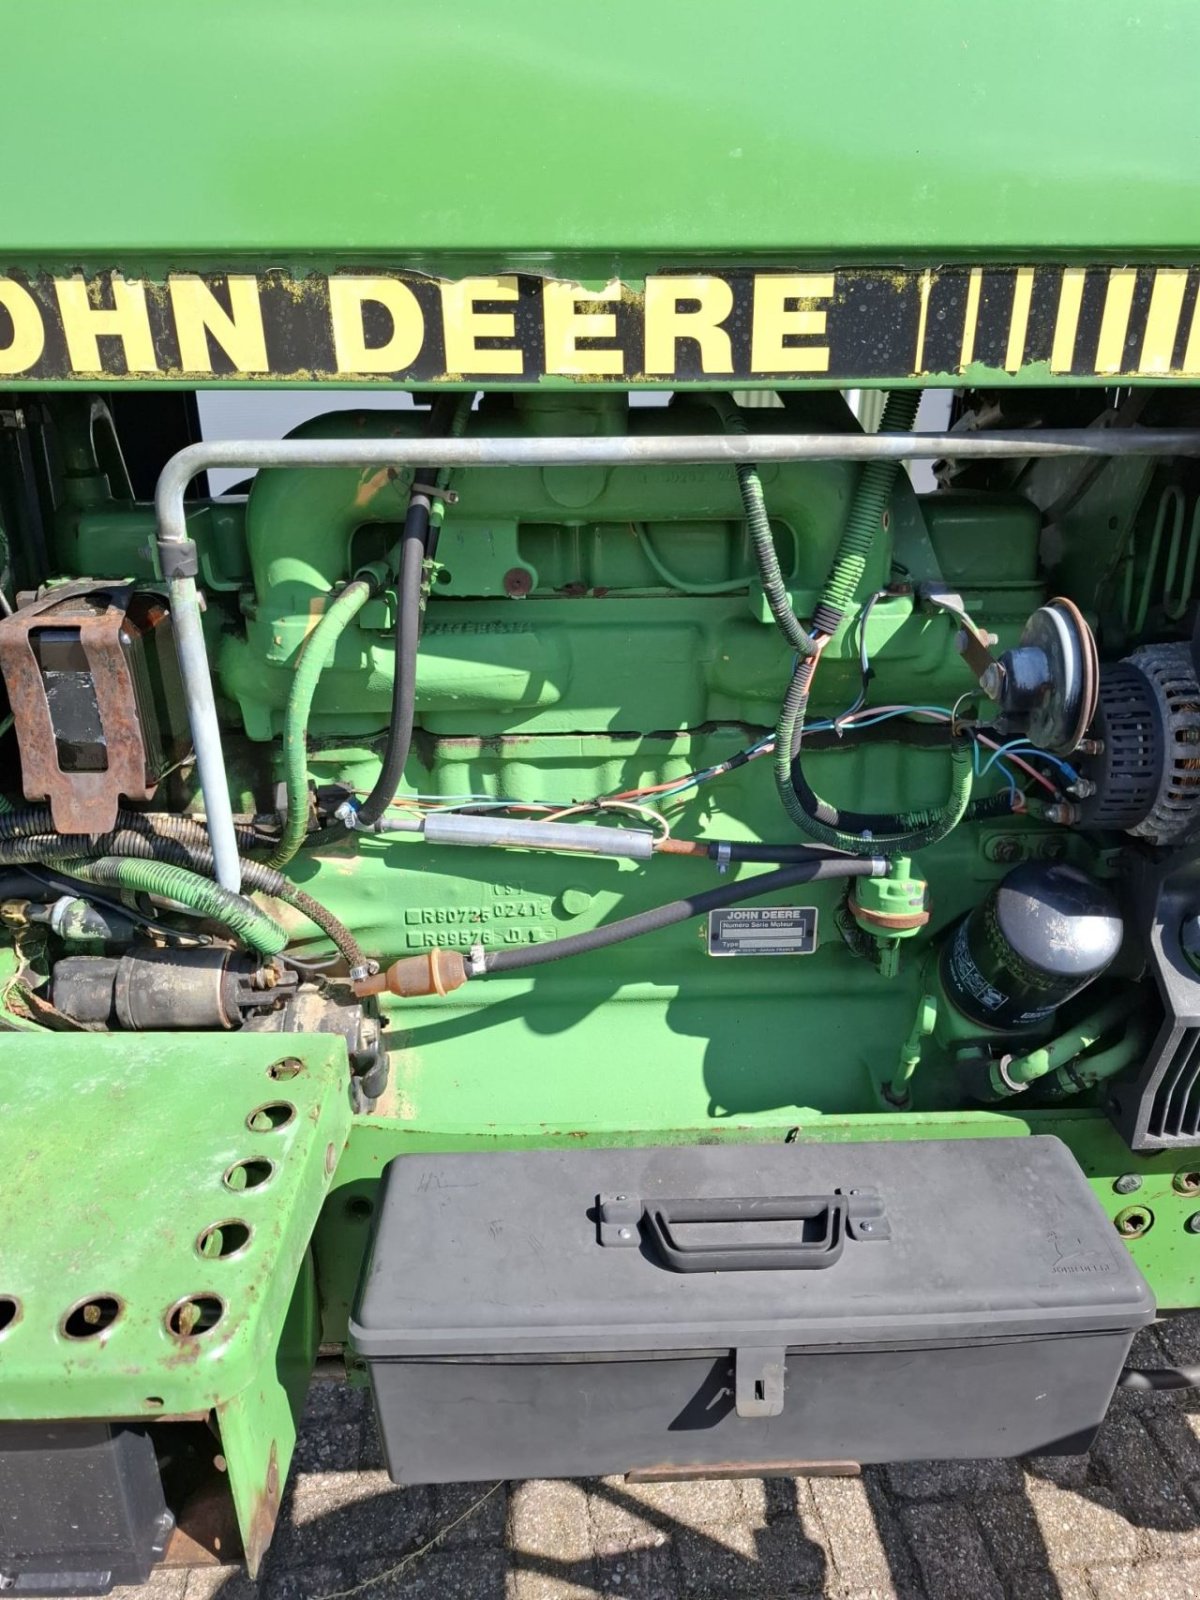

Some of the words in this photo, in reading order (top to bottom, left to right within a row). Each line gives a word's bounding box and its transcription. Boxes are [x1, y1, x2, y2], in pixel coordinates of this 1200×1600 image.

[328, 273, 835, 375] DEERE
[727, 911, 759, 920] JOHN
[761, 910, 801, 919] DEERE
[722, 941, 739, 949] Type
